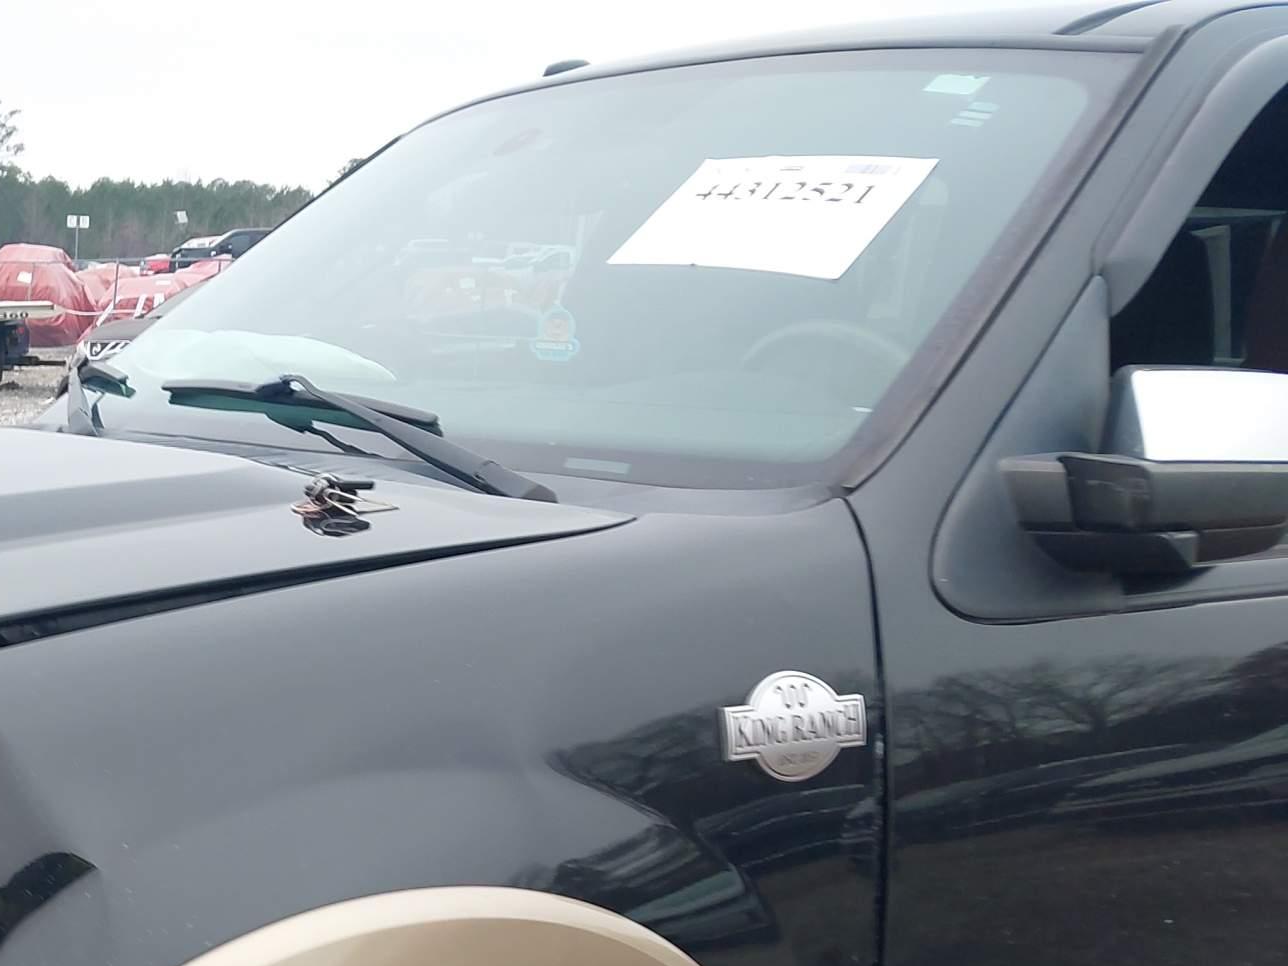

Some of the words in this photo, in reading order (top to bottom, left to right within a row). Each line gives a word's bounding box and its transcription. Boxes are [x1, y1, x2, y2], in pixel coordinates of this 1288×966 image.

[695, 181, 875, 204] 44312521
[732, 714, 789, 748] KING
[791, 703, 862, 742] RANCH
